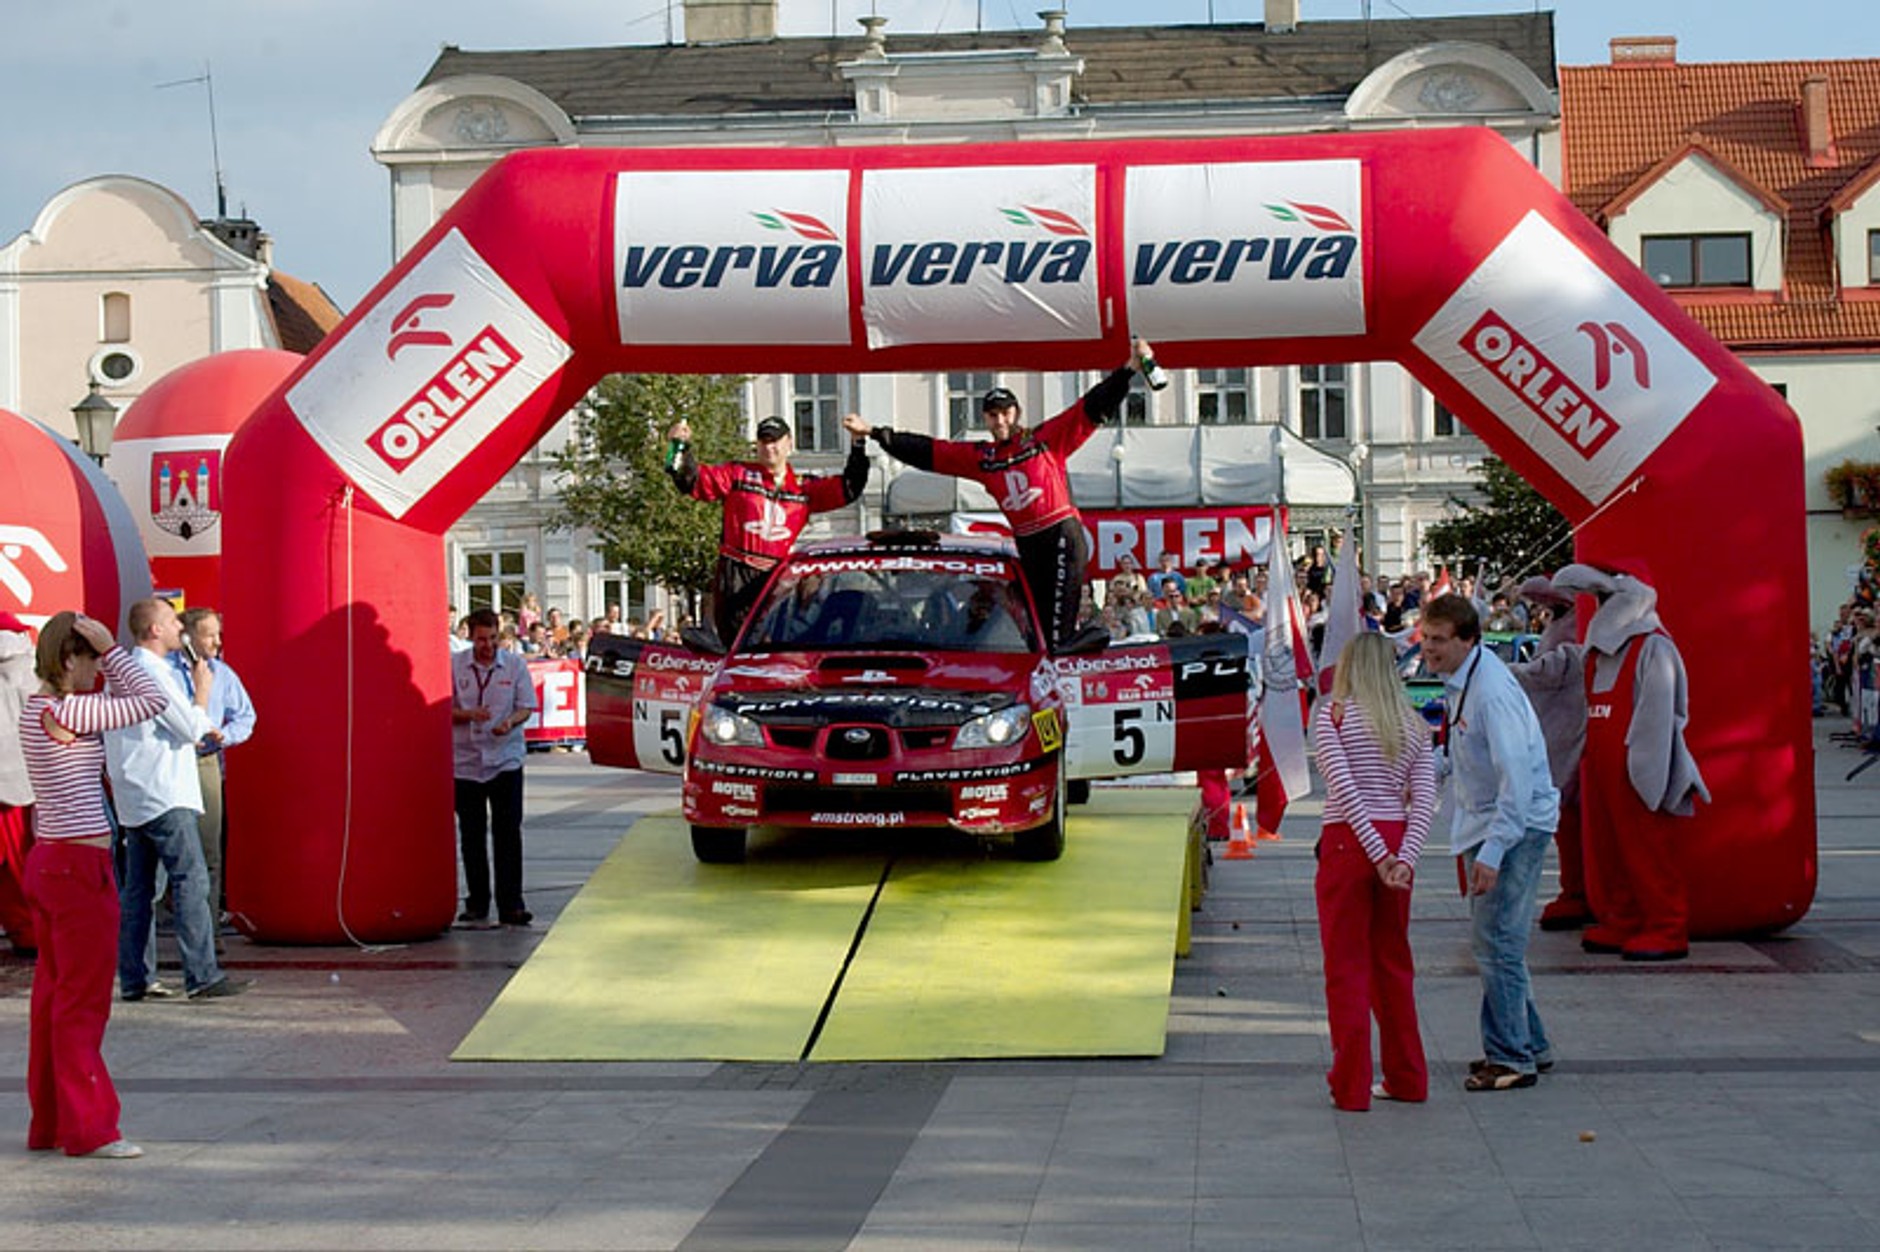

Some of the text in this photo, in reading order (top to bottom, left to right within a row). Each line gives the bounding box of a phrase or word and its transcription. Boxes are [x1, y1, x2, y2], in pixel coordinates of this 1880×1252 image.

[622, 244, 843, 289] verva
[869, 239, 1092, 287] verva
[1132, 235, 1358, 286] verva
[381, 336, 512, 460] ORLEN
[1475, 325, 1608, 450] ORLEN
[791, 556, 1004, 576] www.zibro.pl
[1084, 517, 1273, 571] RLEN
[1181, 657, 1249, 681] PL
[634, 701, 648, 721] N
[1156, 701, 1174, 722] N
[660, 710, 686, 767] 5
[1113, 708, 1146, 767] 5
[712, 780, 757, 796] MOTUL
[960, 783, 1009, 799] MOTUL
